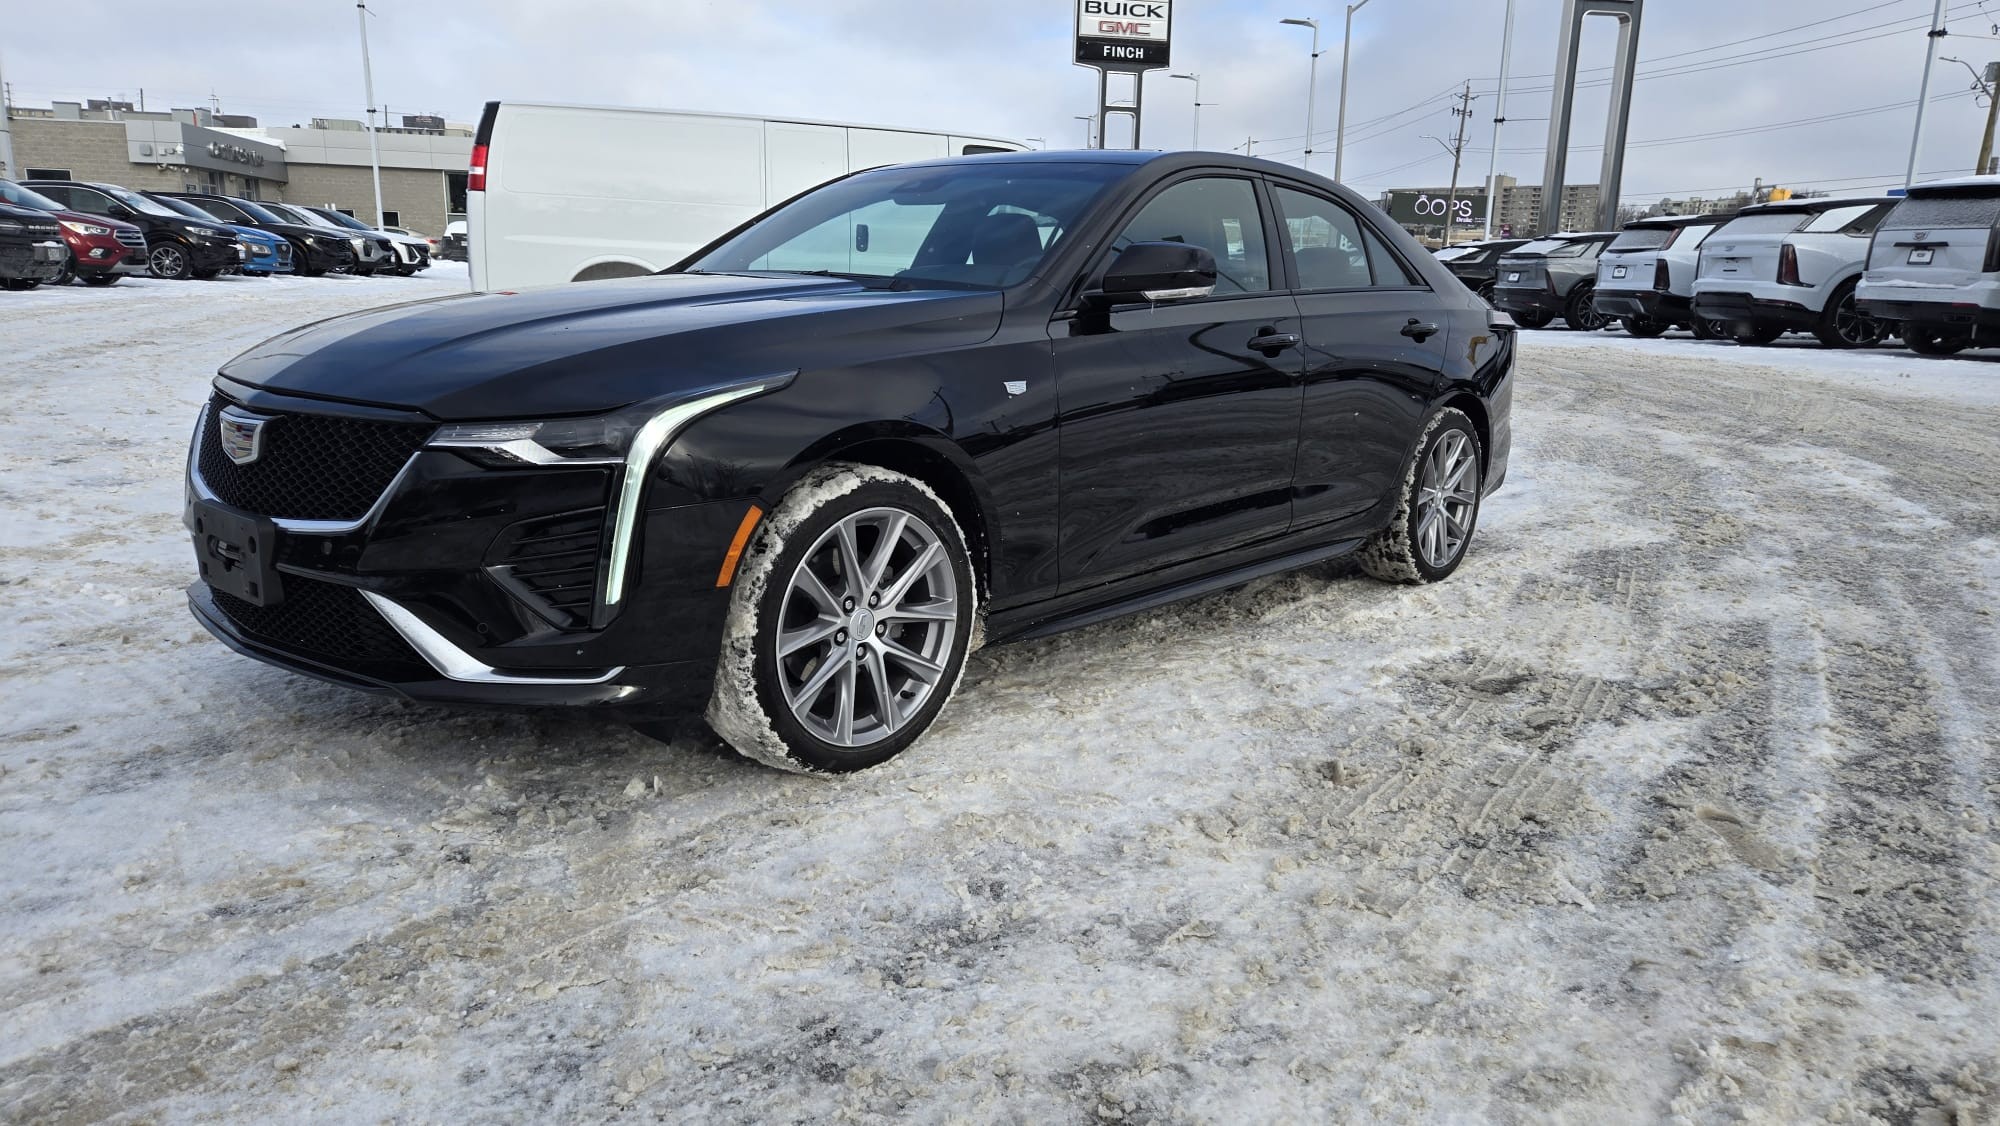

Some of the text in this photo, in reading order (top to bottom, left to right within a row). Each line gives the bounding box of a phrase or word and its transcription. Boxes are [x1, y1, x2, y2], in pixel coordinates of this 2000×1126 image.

[1085, 1, 1164, 18] BUICK
[1098, 21, 1151, 35] GMC
[1103, 45, 1144, 59] FINCH
